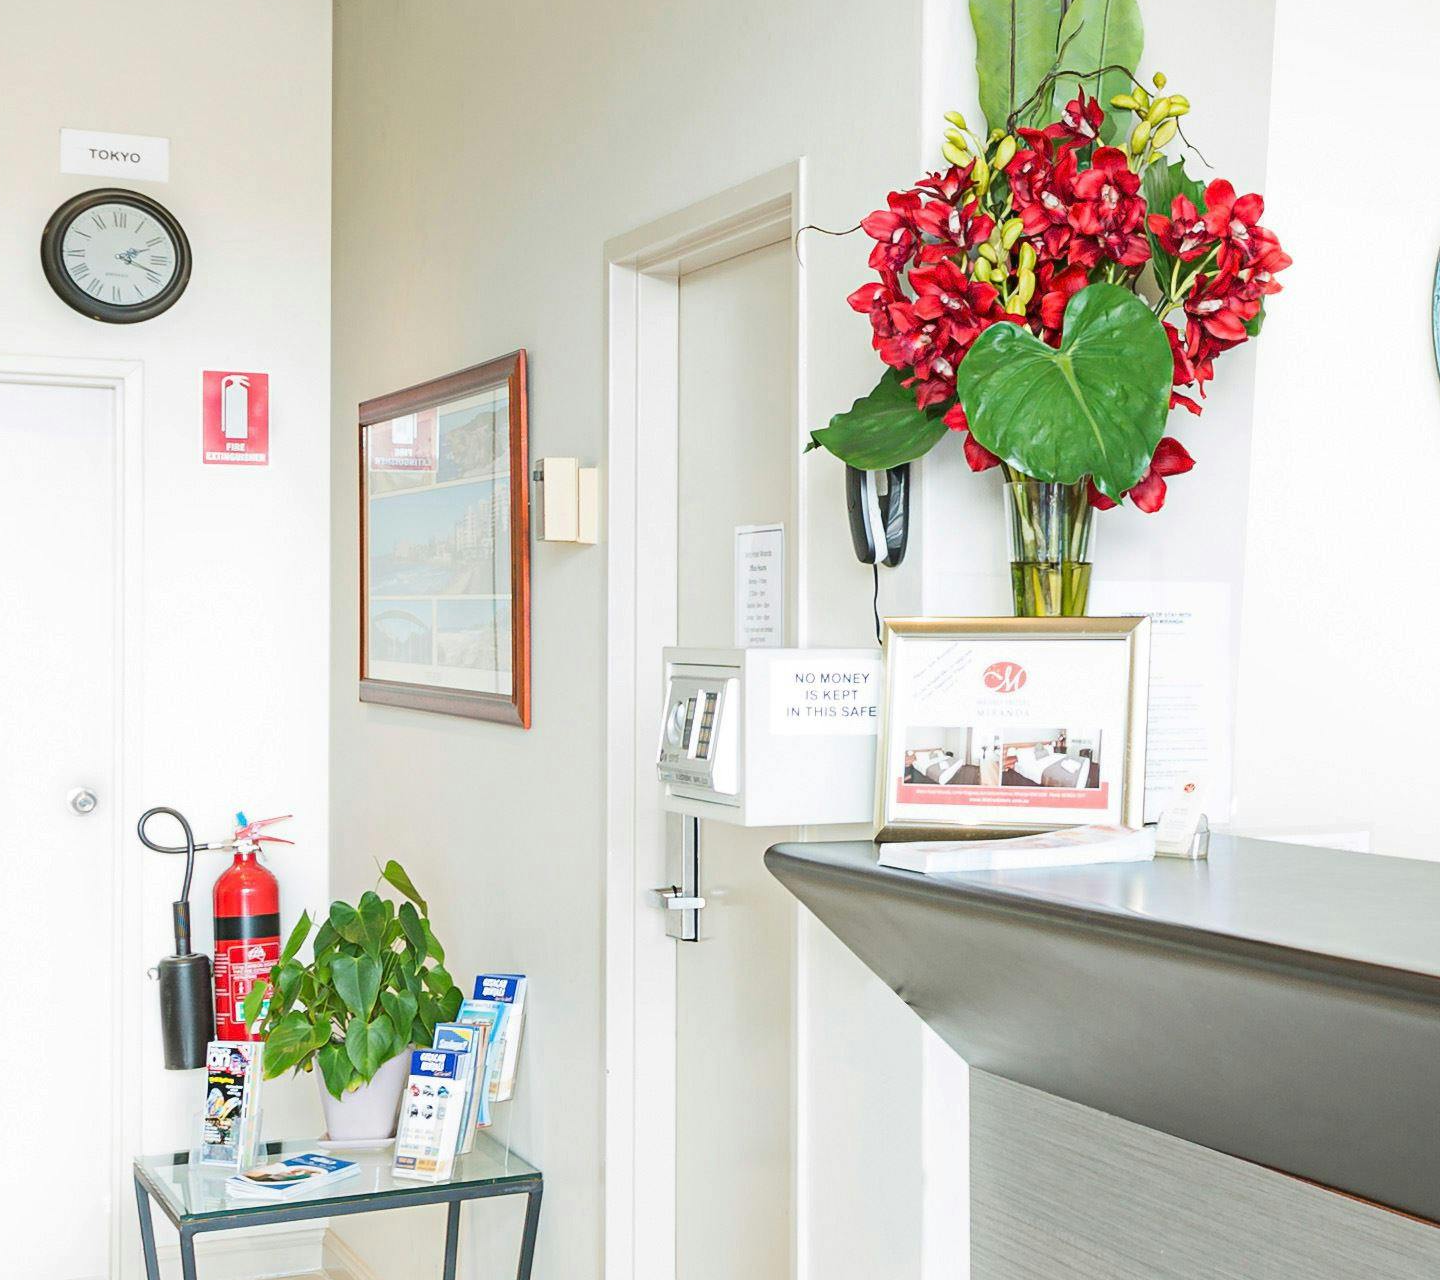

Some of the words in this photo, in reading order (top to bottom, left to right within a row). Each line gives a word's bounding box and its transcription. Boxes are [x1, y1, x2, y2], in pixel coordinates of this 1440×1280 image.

[88, 147, 142, 164] TOKYO
[795, 673, 815, 684] NO
[820, 673, 870, 684] MONEY
[806, 690, 818, 700] IS
[823, 690, 858, 701] KEPT
[787, 706, 800, 717] IN
[806, 706, 837, 717] THIS
[842, 706, 877, 717] SAFE
